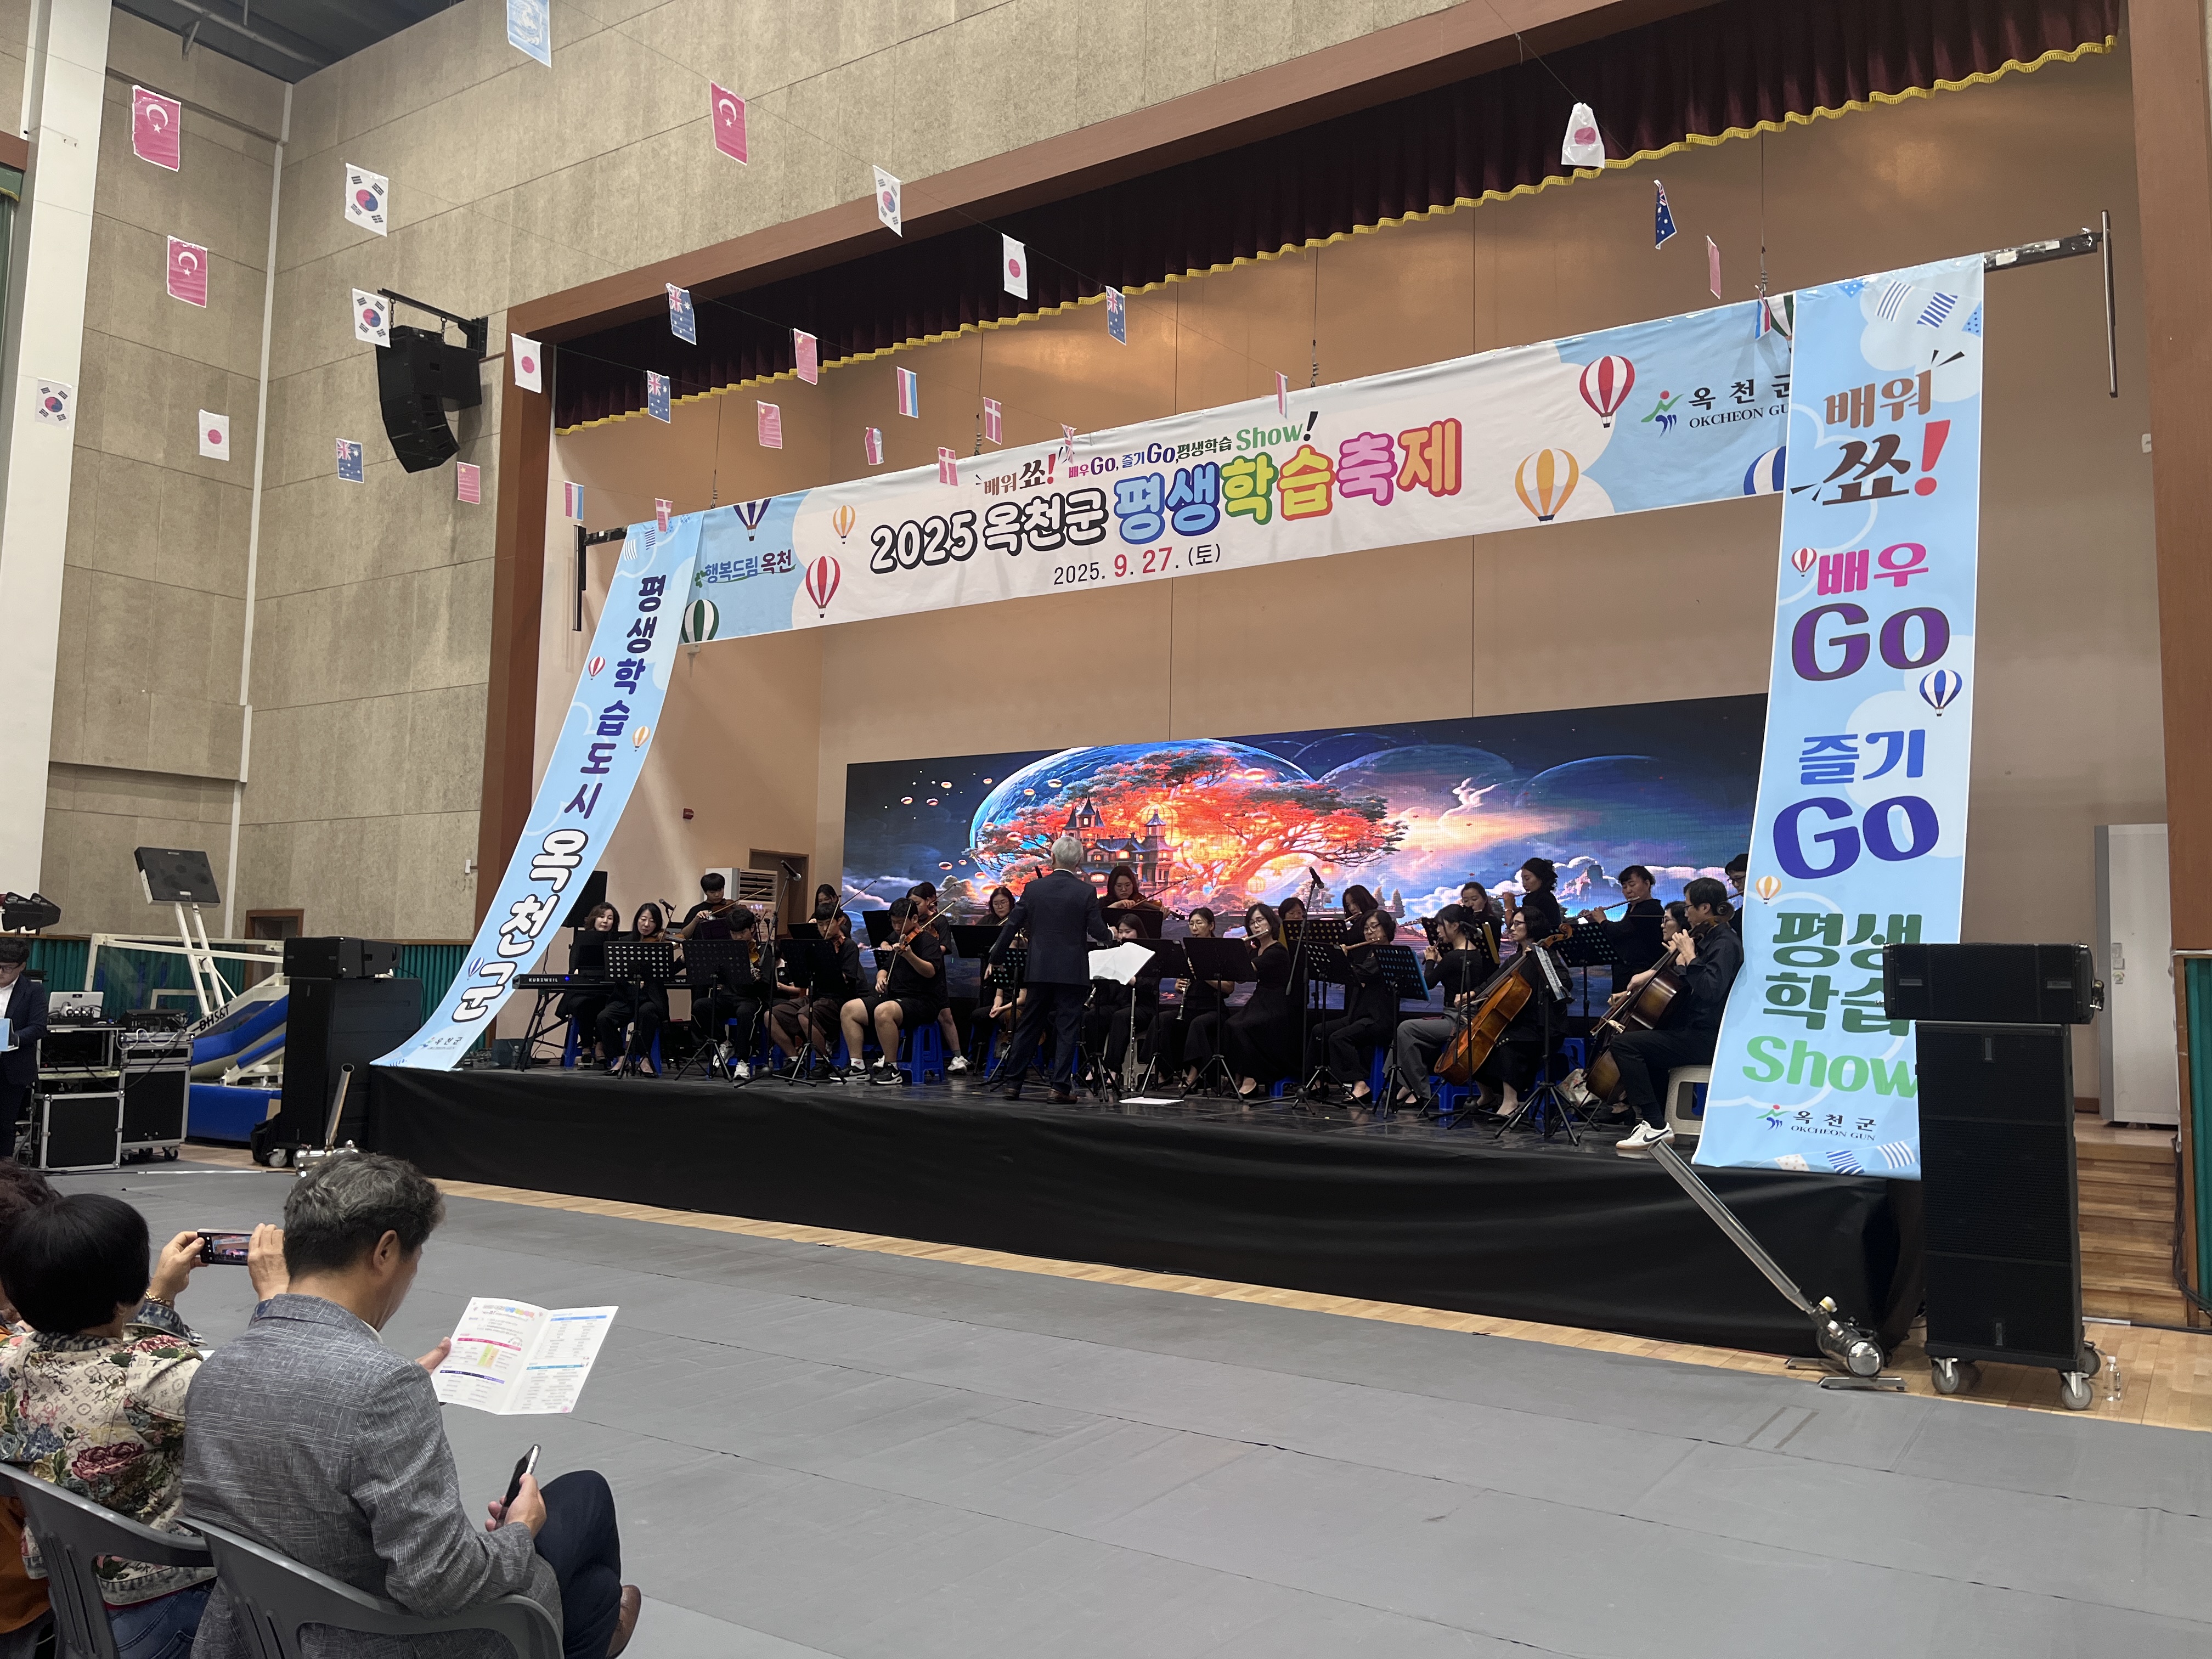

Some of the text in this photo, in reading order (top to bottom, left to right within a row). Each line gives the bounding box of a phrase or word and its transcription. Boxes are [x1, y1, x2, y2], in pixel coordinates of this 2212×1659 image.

[1689, 403, 1789, 428] OKCHEON GU
[1823, 369, 1931, 429] 배워
[1236, 411, 1318, 452] Show!
[1822, 419, 1951, 506] 쑈!
[870, 510, 978, 574] 2025
[983, 488, 1109, 556] 옥천군
[1054, 543, 1221, 585] 2025. 9. 27. (토)
[1817, 542, 1928, 596] 배우
[1792, 602, 1950, 681] Go
[1799, 729, 1925, 785] 즐기
[452, 574, 667, 1022] 평생학습도시 옥천군
[1773, 795, 1939, 879] Go
[1791, 1125, 1875, 1141] OKCHEON GUN
[1793, 1111, 1876, 1132] 옥천군
